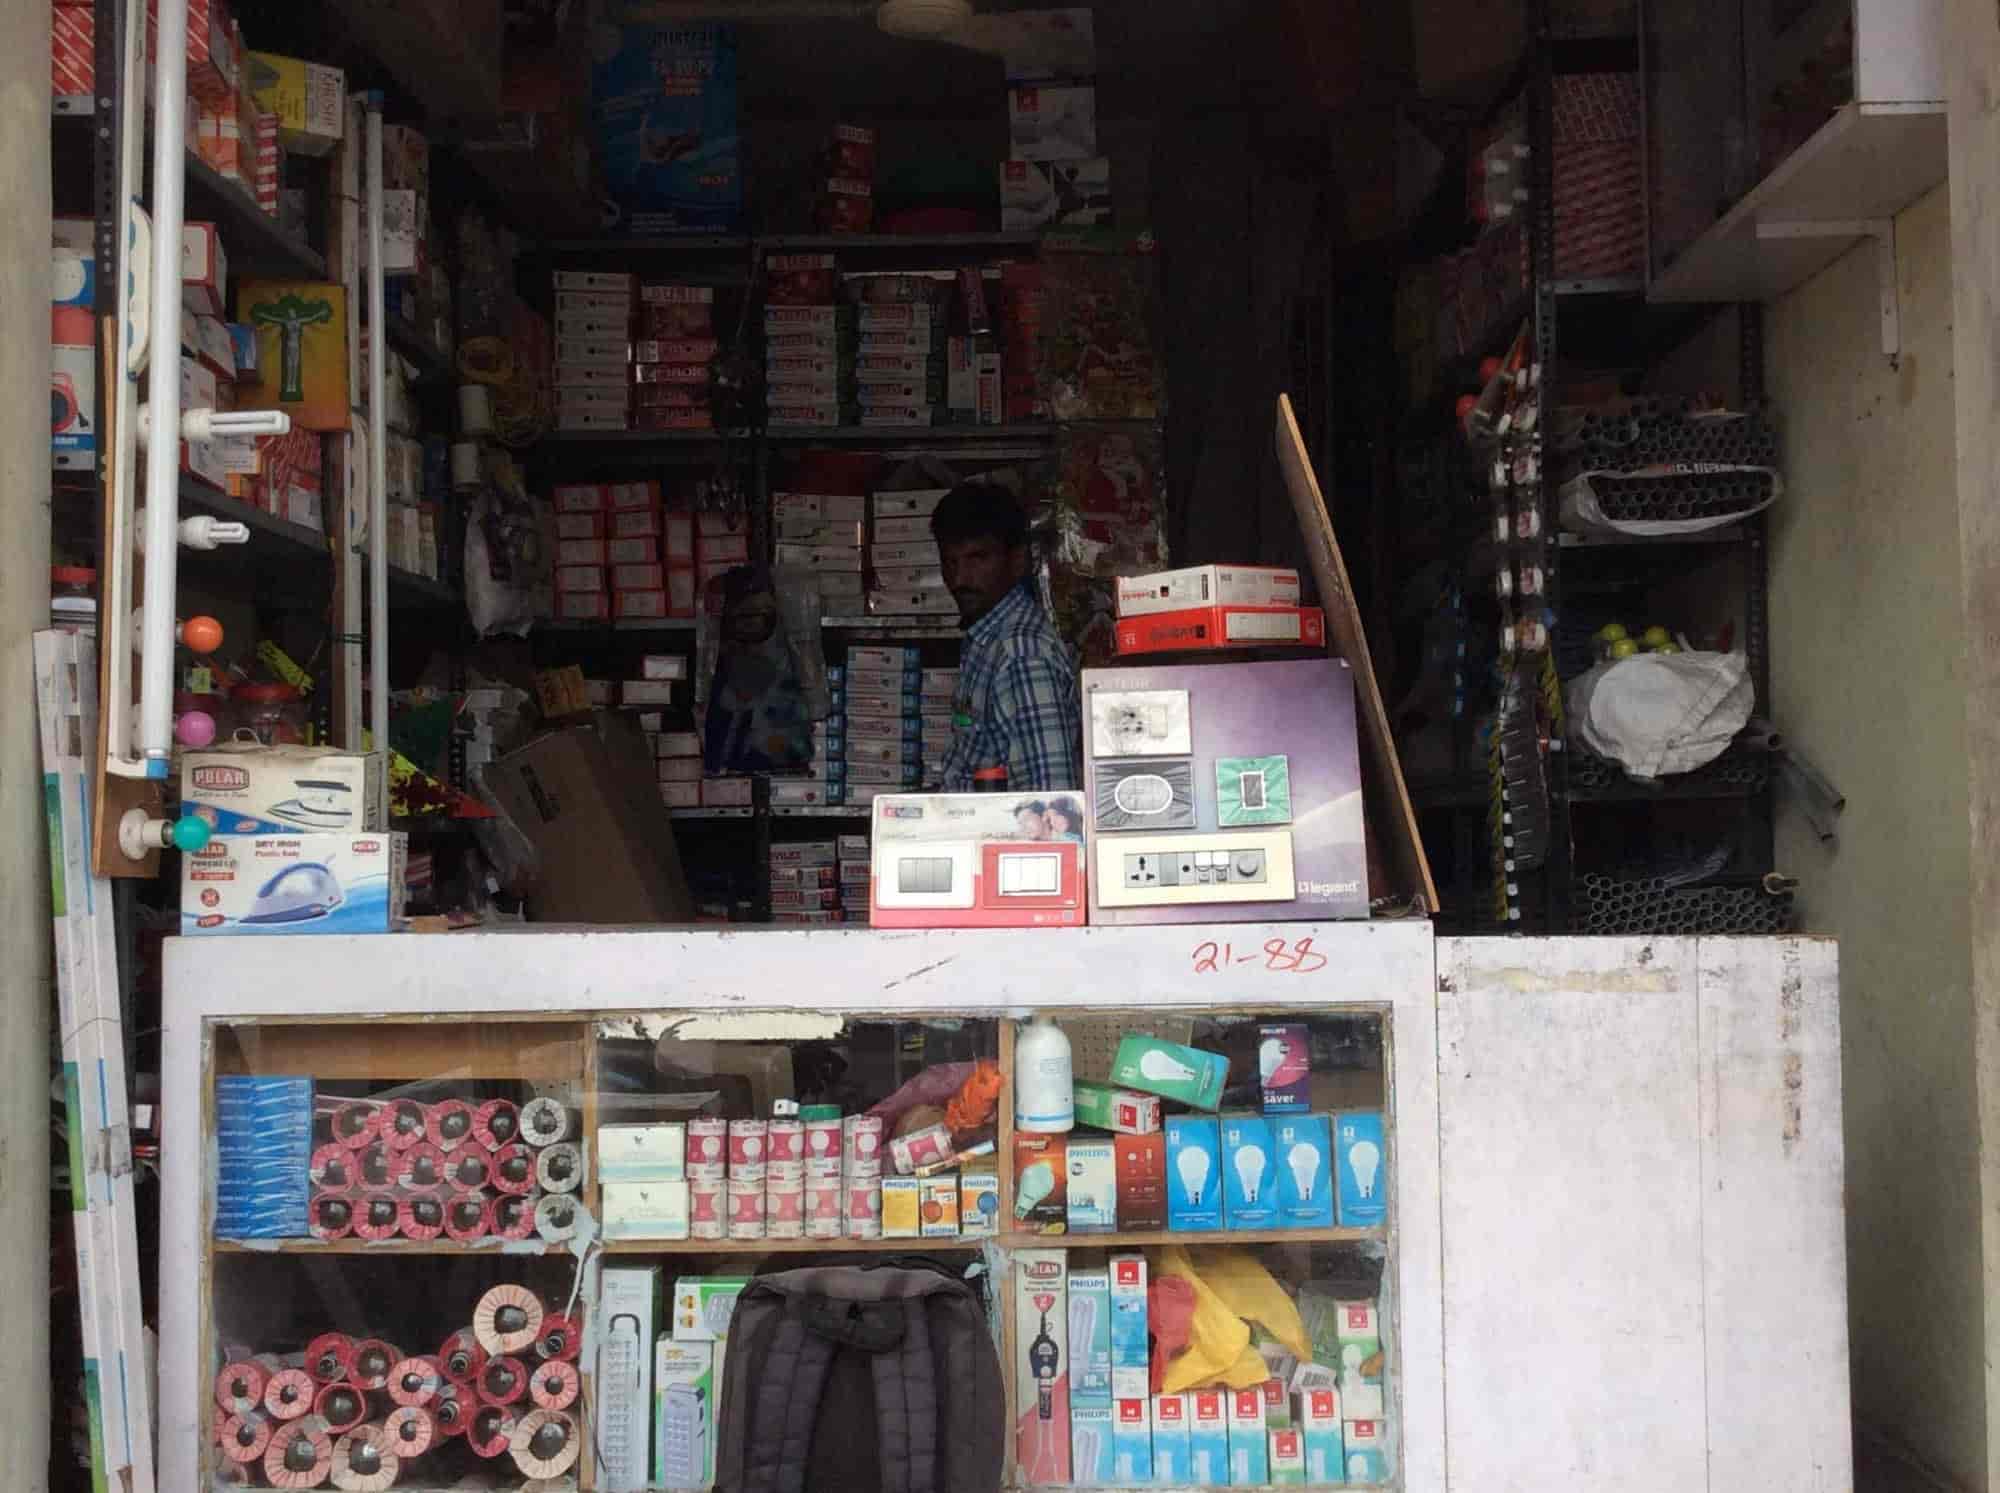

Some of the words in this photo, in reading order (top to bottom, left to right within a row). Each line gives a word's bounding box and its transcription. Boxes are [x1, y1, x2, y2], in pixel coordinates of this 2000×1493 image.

[194, 767, 245, 787] POLAR
[1263, 1094, 1295, 1104] saver
[1070, 1279, 1106, 1288] PHILIPS
[1074, 1410, 1110, 1419] PHILIPS
